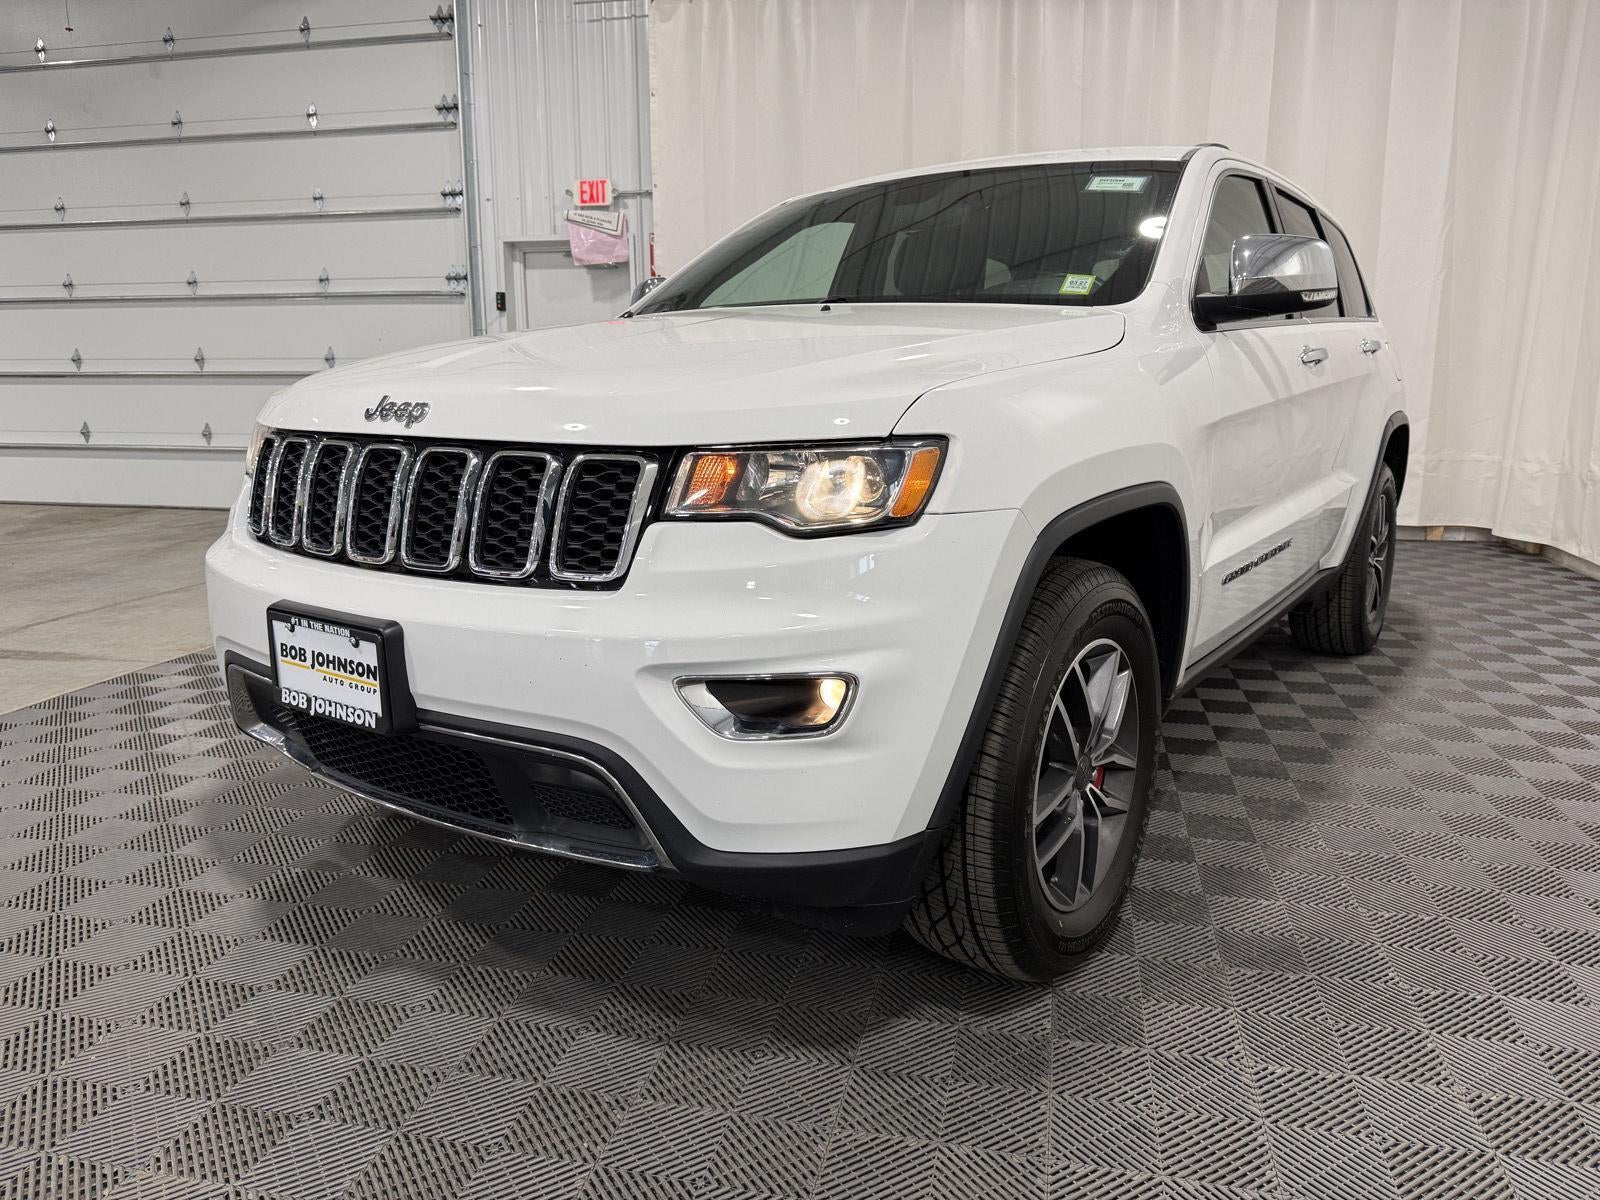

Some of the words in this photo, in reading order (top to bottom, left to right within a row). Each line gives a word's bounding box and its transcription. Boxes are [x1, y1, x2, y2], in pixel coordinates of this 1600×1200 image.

[580, 180, 607, 204] EXIT
[364, 395, 430, 429] Jeep
[300, 619, 308, 628] IN
[309, 621, 323, 631] THE
[325, 624, 351, 638] NATION
[280, 642, 307, 662] BOB
[310, 650, 378, 681] JOHNSON
[323, 675, 344, 686] AUTO
[349, 682, 378, 695] GROUP
[281, 687, 308, 708] BOB
[310, 695, 376, 728] JOHNSON
